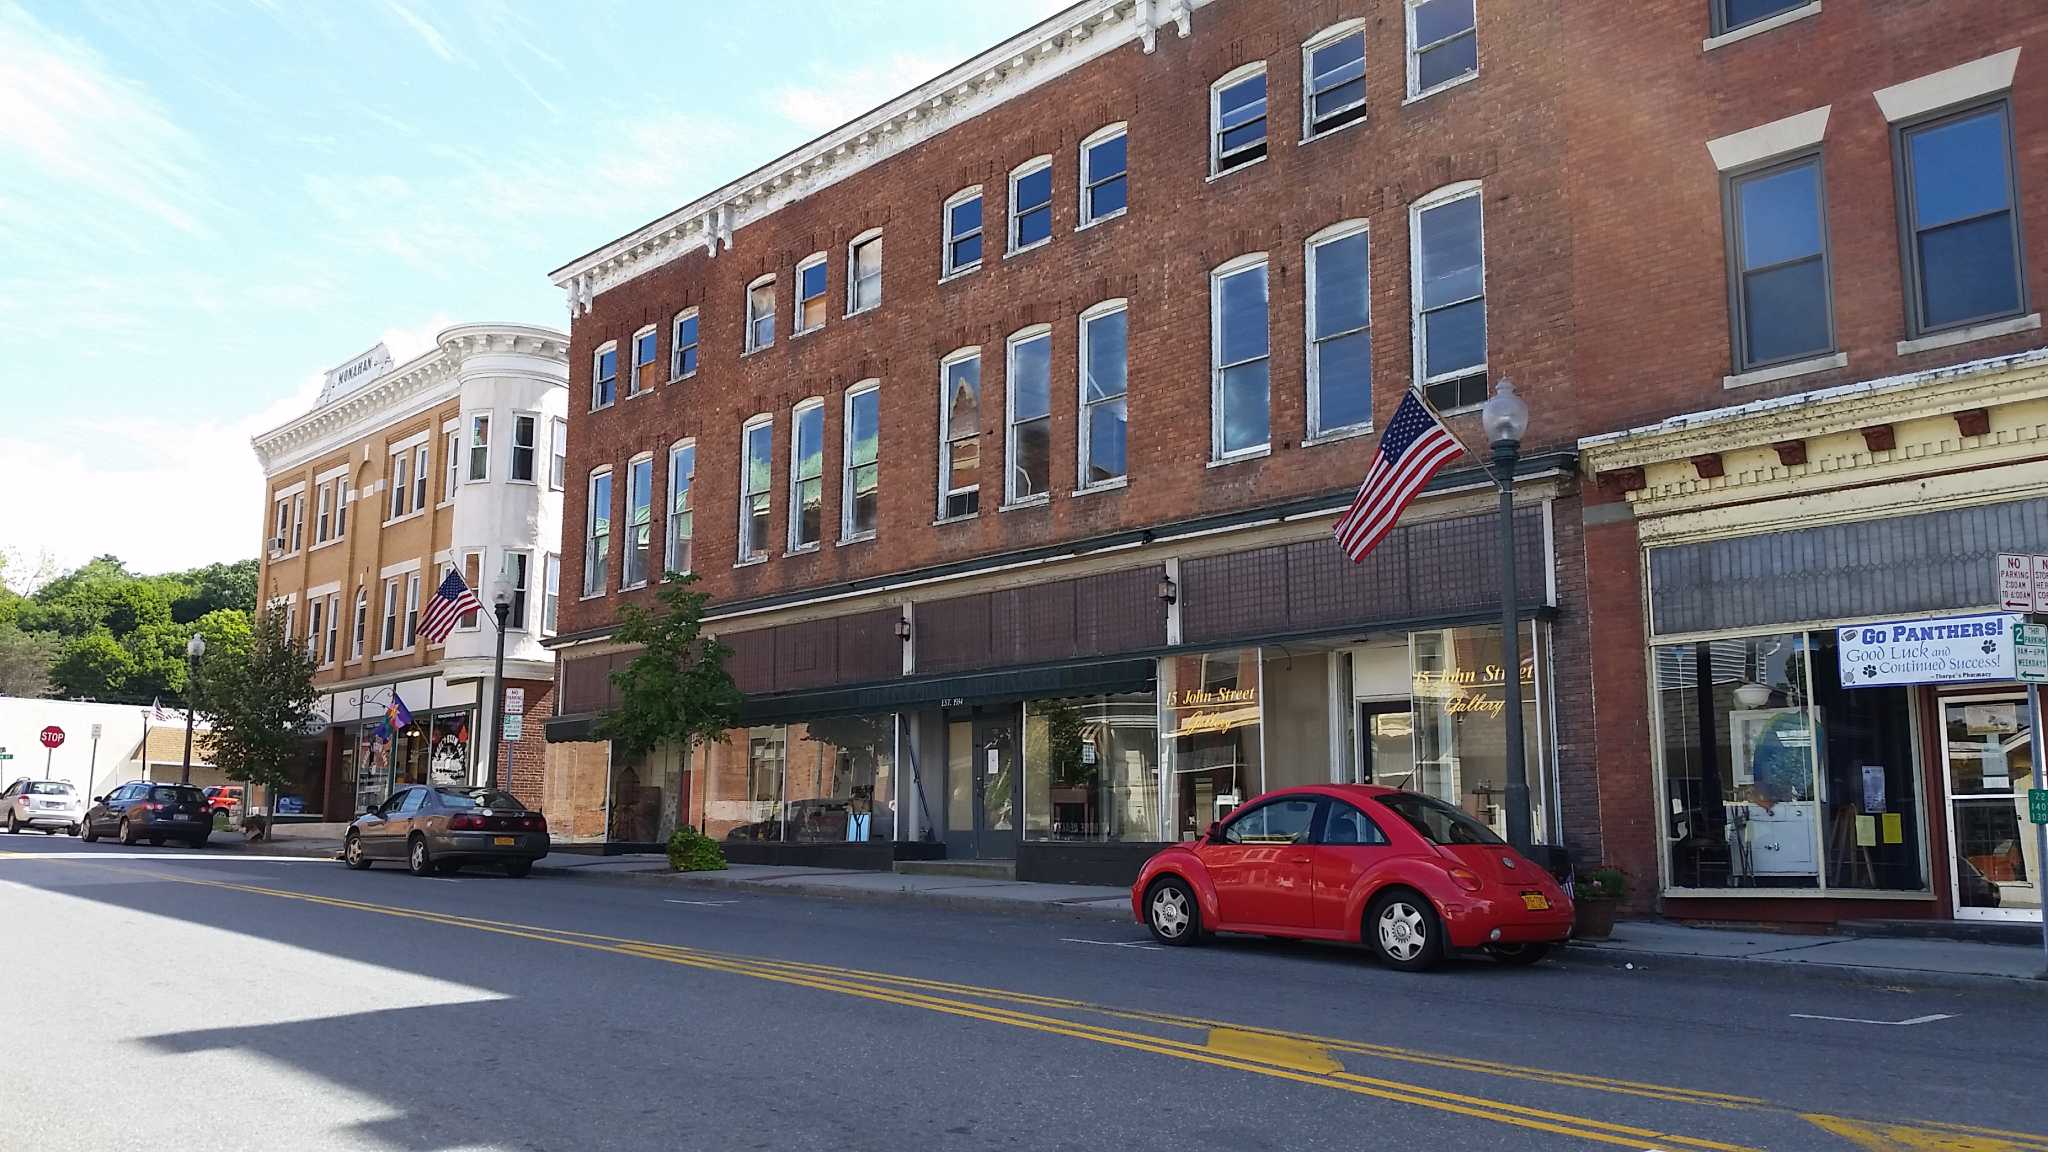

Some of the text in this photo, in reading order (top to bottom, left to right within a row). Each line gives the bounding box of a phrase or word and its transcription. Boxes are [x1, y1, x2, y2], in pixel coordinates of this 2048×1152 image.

[337, 357, 373, 385] MONAHAN
[2007, 558, 2020, 569] NO
[2000, 570, 2029, 579] PARKING
[2001, 590, 2008, 598] TO
[2005, 580, 2026, 589] 2:00AM
[1892, 618, 2004, 643] PANTHERS!
[2015, 627, 2024, 642] 2
[1846, 641, 1950, 663] Good Luck and
[1441, 667, 1475, 682] John
[1483, 663, 1535, 682] Stret
[1879, 654, 2001, 674] Continued Success!
[1166, 686, 1255, 706] 15 John Street
[1444, 693, 1506, 719] Gallery
[1186, 710, 1232, 735] Gallery
[41, 731, 64, 742] STOP
[2031, 802, 2048, 812] 140
